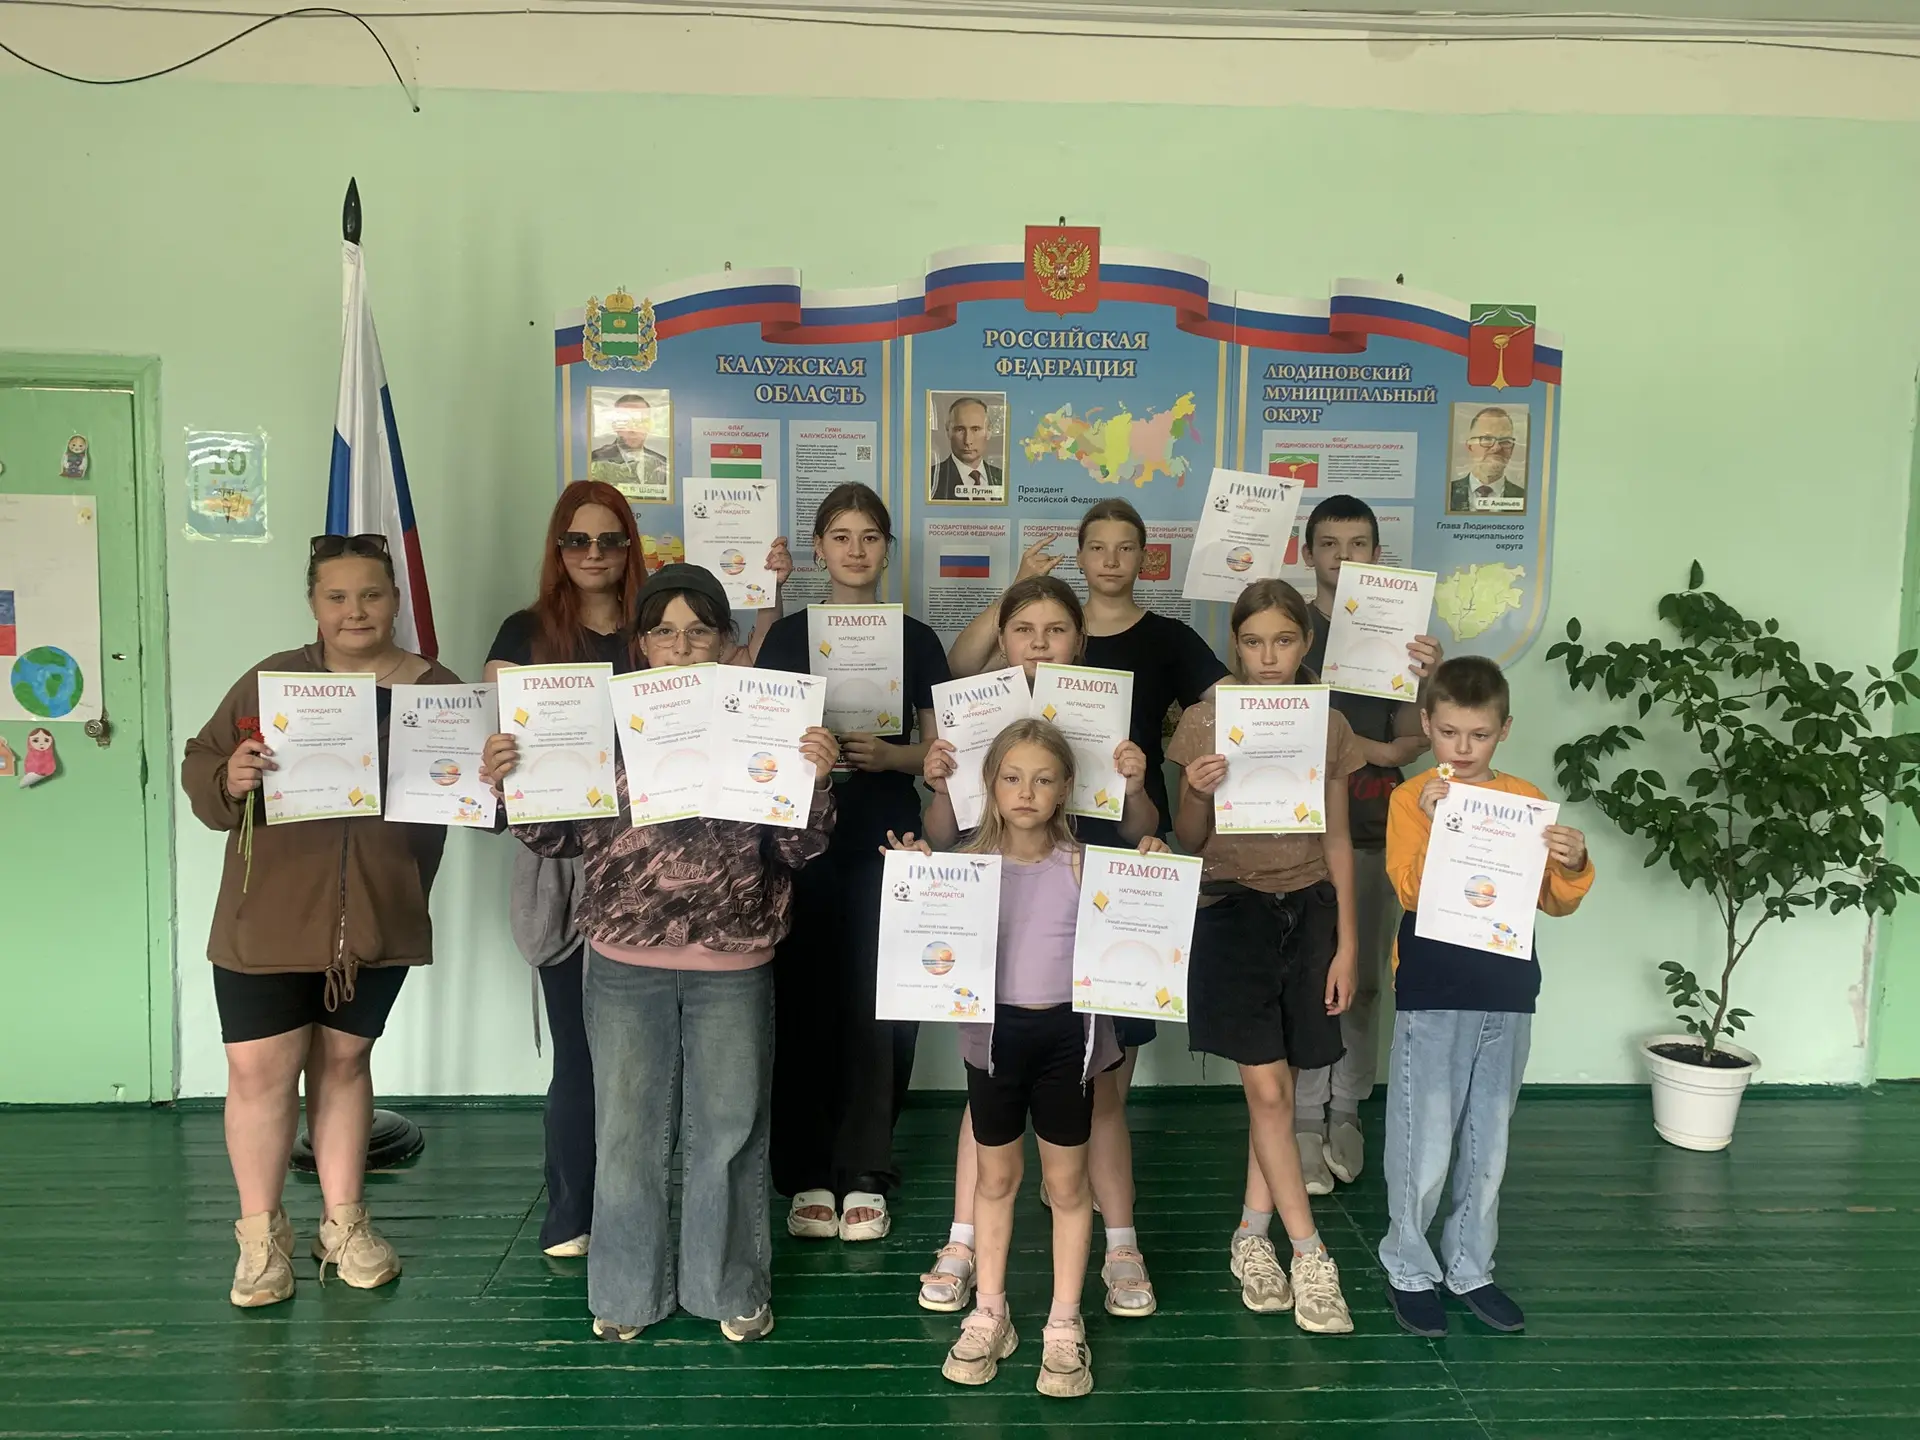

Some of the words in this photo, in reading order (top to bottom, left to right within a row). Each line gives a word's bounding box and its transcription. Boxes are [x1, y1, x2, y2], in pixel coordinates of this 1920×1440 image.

[984, 326, 1149, 350] РОССИЙСКАЯ
[717, 355, 866, 377] КАЛУЖСКАЯ
[995, 357, 1137, 381] ФЕДЕРАЦИЯ
[1265, 363, 1412, 382] ЛЮДИНОВСКИЙ
[755, 384, 866, 404] ОБЛАСТЬ
[1264, 385, 1438, 405] МУНИЦИПАЛЬНЫЙ
[1264, 407, 1323, 423] ОКРУГ
[208, 448, 247, 475] 10
[704, 489, 762, 501] ГРАМОТА
[972, 487, 993, 496] Путин
[1018, 485, 1064, 494] Президент
[1229, 483, 1285, 501] ГРАМОТА
[1018, 495, 1069, 504] Российской
[1437, 522, 1461, 530] Глава
[1463, 522, 1524, 531] Людиновского
[1453, 533, 1524, 541] муниципального
[1495, 543, 1524, 551] округа
[1359, 574, 1418, 592] ГРАМОТА
[827, 615, 887, 627] ГРАМОТА
[283, 684, 356, 697] ГРАМОТА
[523, 676, 595, 690] ГРАМОТА
[633, 673, 701, 697] ГРАМОТА
[739, 679, 806, 700] ГРАМОТА
[1057, 676, 1119, 695] ГРАМОТА
[949, 683, 1010, 706] ГРАМОТА
[417, 696, 482, 709] ГРАМОТА
[649, 700, 691, 711] НАГРАЖДАЕТСЯ
[748, 704, 790, 714] НАГРАЖДАЕТСЯ
[1240, 697, 1310, 710] ГРАМОТА
[1463, 798, 1534, 826] ГРАМОТА
[1471, 824, 1516, 839] НАГРАЖДАЕТСЯ
[909, 865, 980, 883] ГРАМОТА
[1108, 861, 1180, 882] ГРАМОТА
[920, 891, 964, 899] НАГРАЖДАЕТСЯ
[1119, 888, 1162, 898] НАГРАЖДАЕТСЯ
